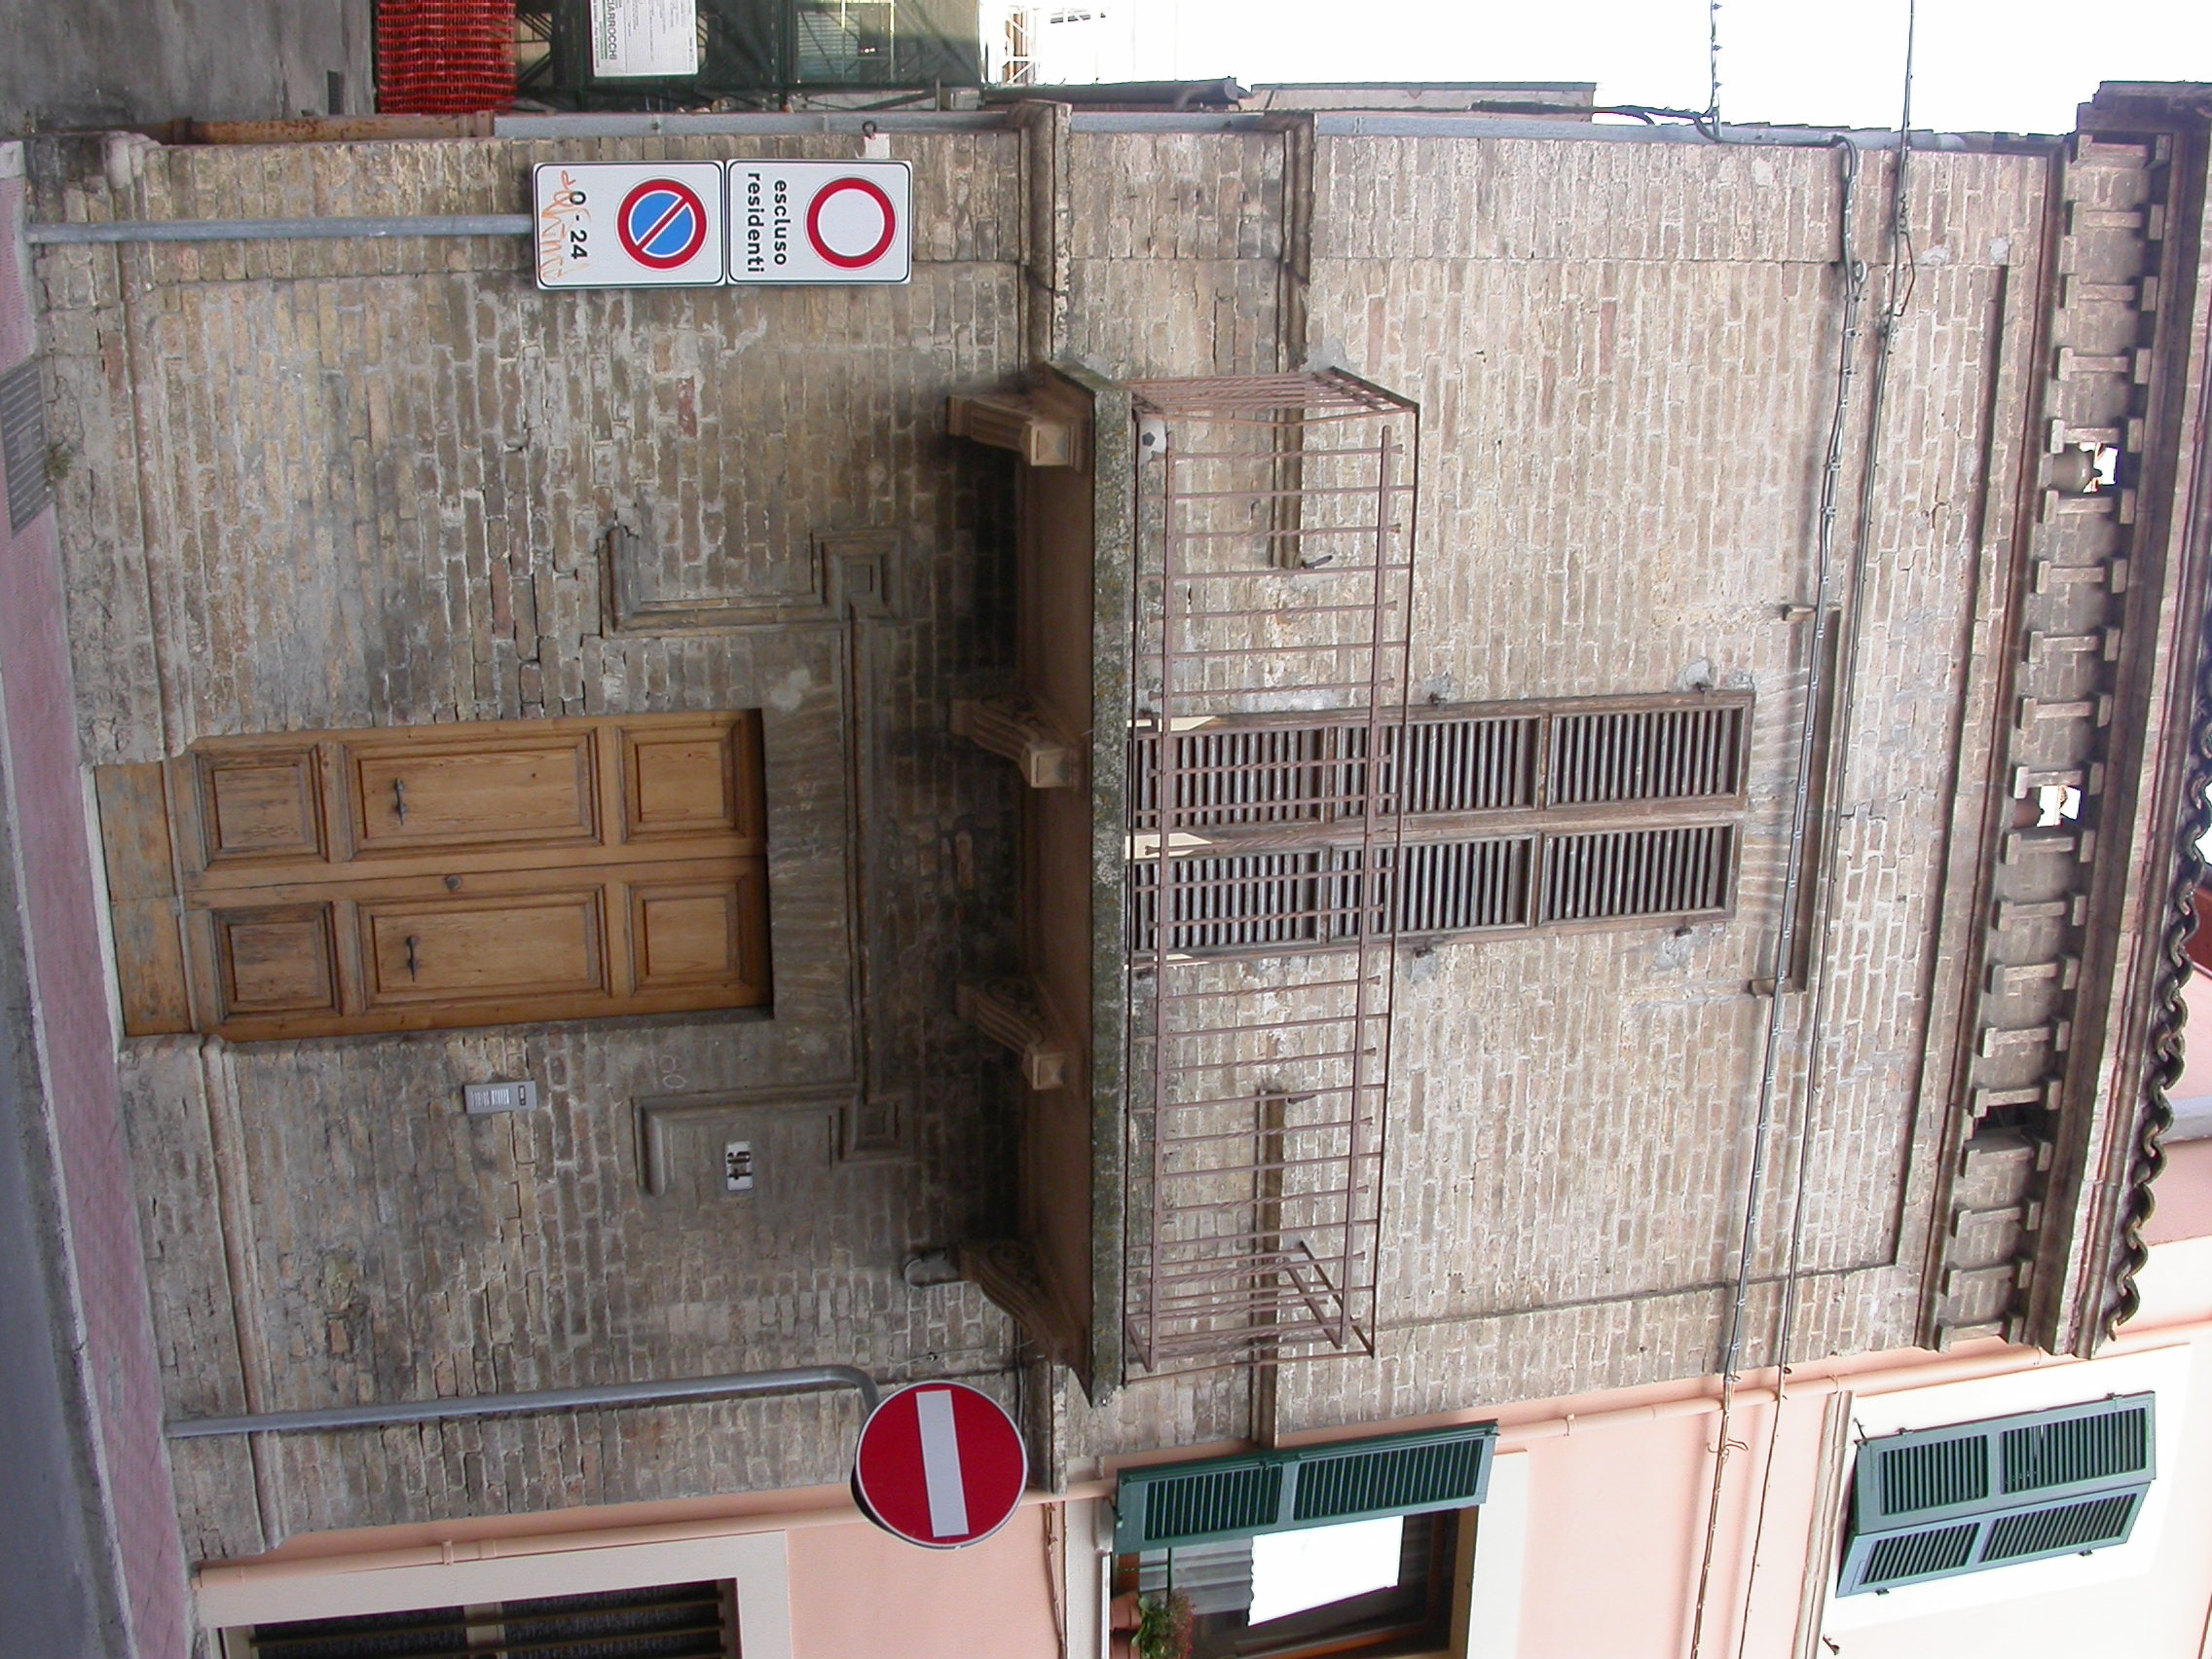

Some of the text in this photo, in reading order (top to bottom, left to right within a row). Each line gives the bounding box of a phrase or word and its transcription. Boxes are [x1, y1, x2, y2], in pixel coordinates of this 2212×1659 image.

[570, 191, 586, 205] 0
[748, 172, 765, 273] residenti
[774, 180, 791, 265] escluso
[571, 230, 587, 259] 24
[727, 1152, 752, 1180] 94
